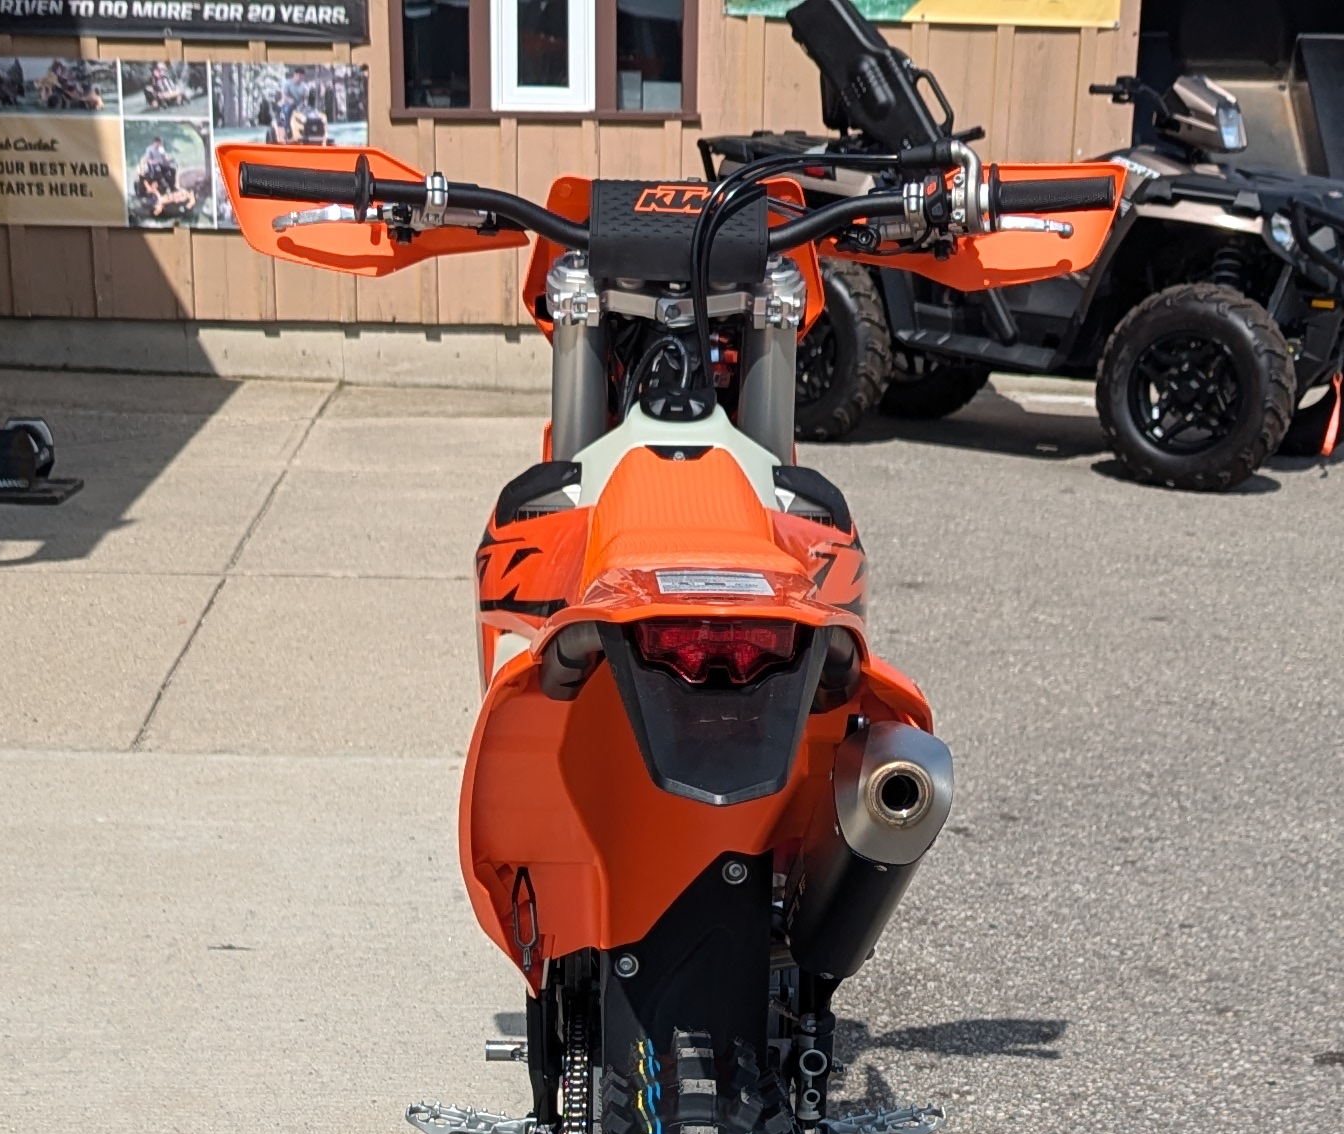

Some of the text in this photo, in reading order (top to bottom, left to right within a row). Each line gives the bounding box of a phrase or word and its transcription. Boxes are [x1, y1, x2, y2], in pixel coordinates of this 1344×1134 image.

[68, 0, 95, 18] TO
[98, 1, 128, 18] DO
[203, 3, 244, 21] FOR
[247, 4, 275, 22] 20
[279, 4, 350, 25] YEARS.
[29, 161, 67, 176] BEST
[69, 162, 109, 176] YARD
[48, 183, 94, 198] HERE.
[634, 185, 724, 214] KTM
